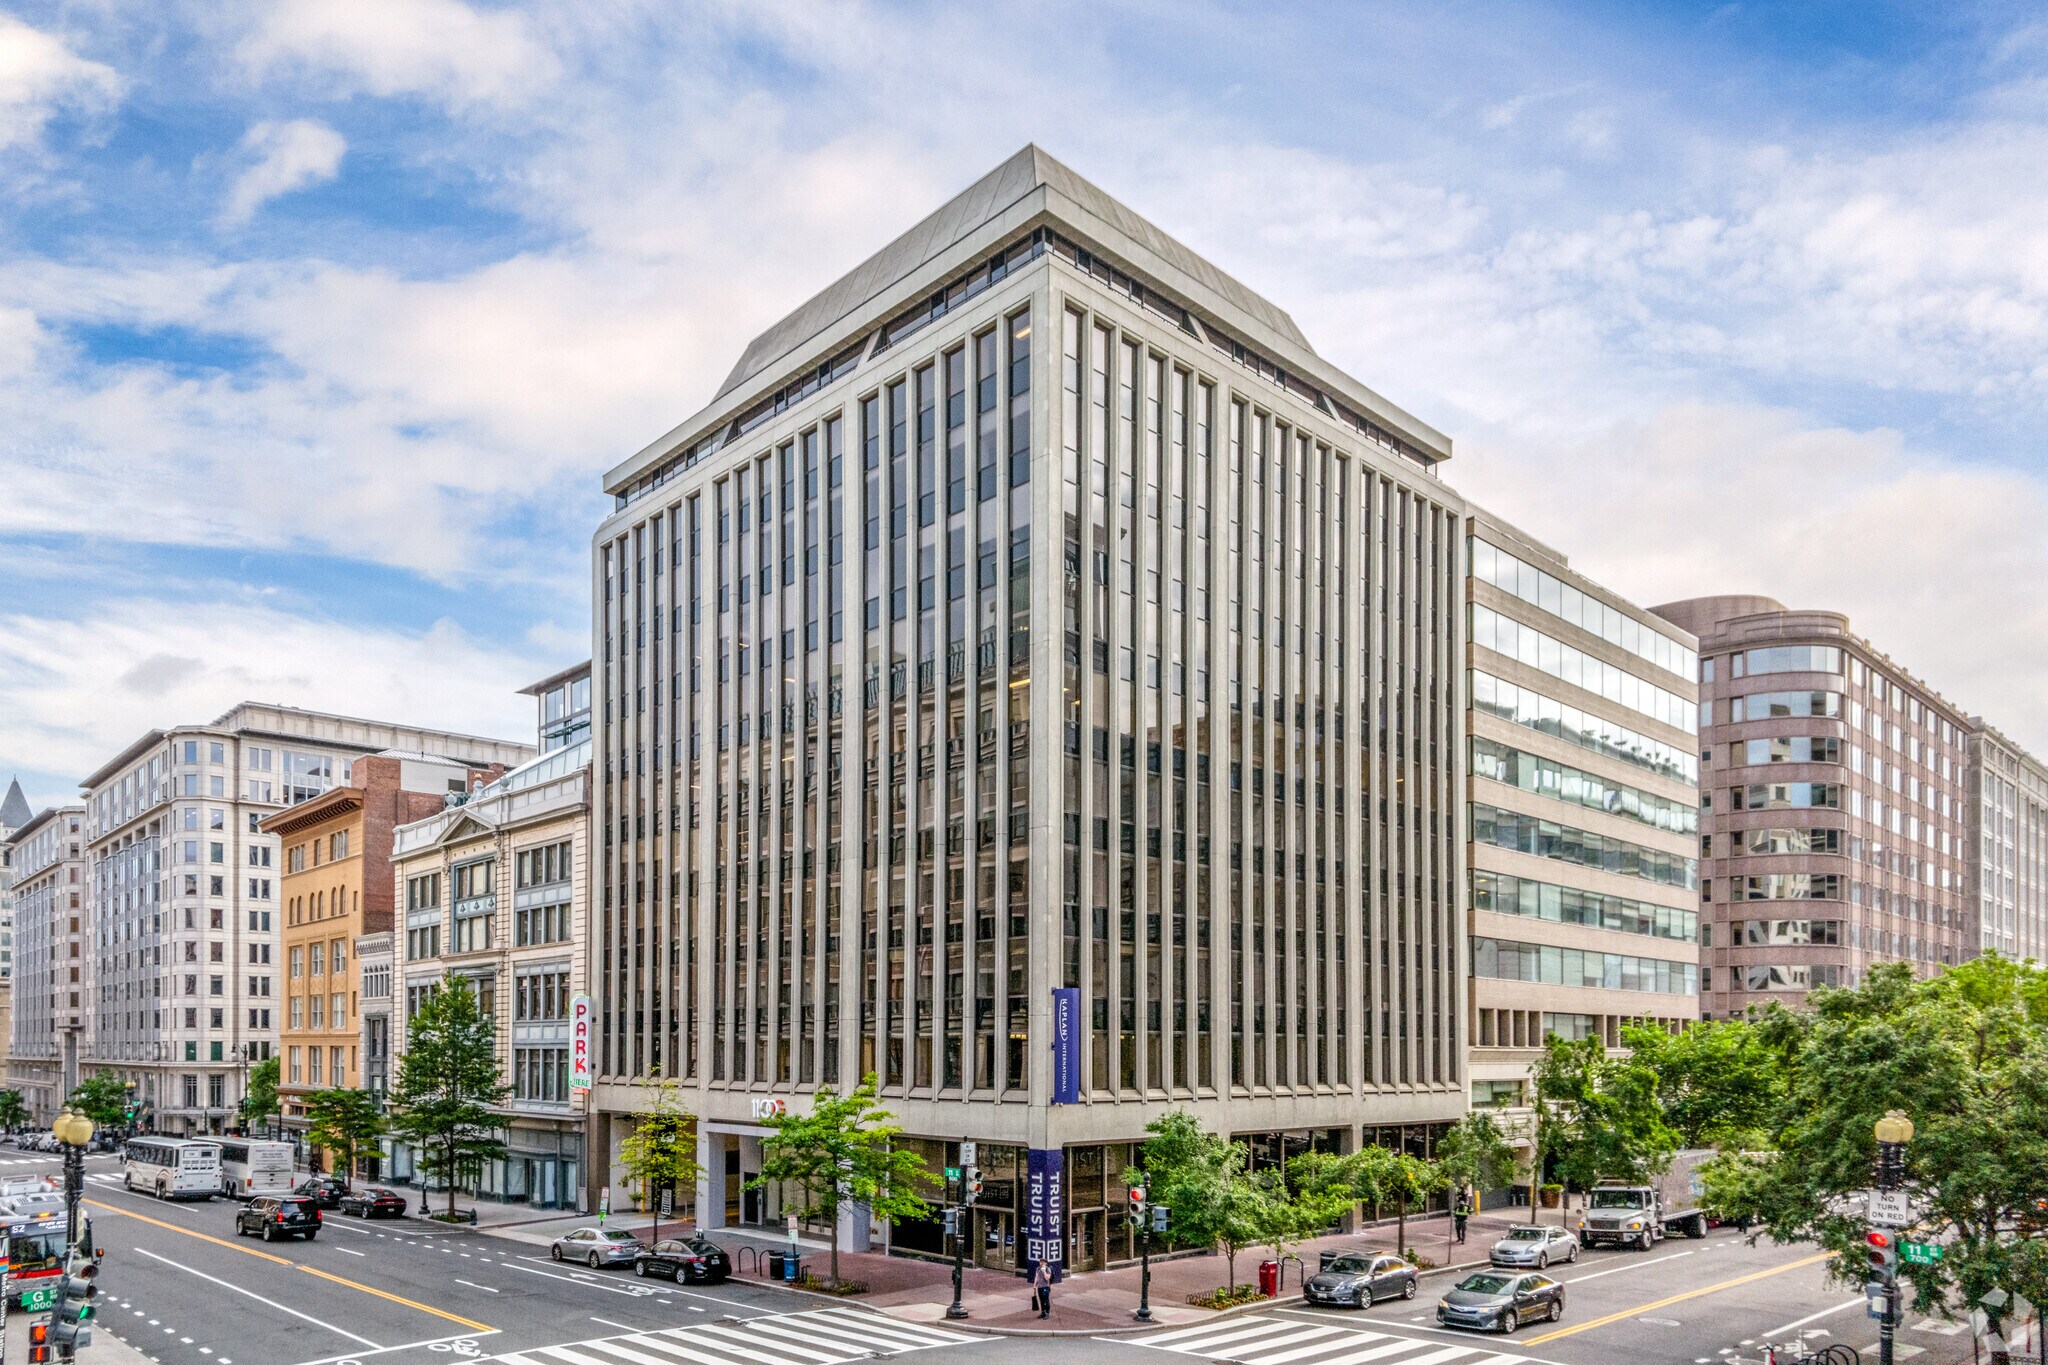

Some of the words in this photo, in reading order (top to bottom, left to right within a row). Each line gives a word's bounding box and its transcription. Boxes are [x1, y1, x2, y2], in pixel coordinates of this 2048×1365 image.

[575, 1004, 587, 1073] PARK
[573, 1078, 589, 1087] HERE
[1031, 1172, 1043, 1237] TRUIST
[1049, 1172, 1060, 1236] TRUIST
[1877, 1203, 1900, 1211] TURN
[1908, 1244, 1921, 1255] 11
[1910, 1255, 1929, 1263] 700
[33, 1291, 44, 1302] G
[30, 1301, 52, 1311] 1000
